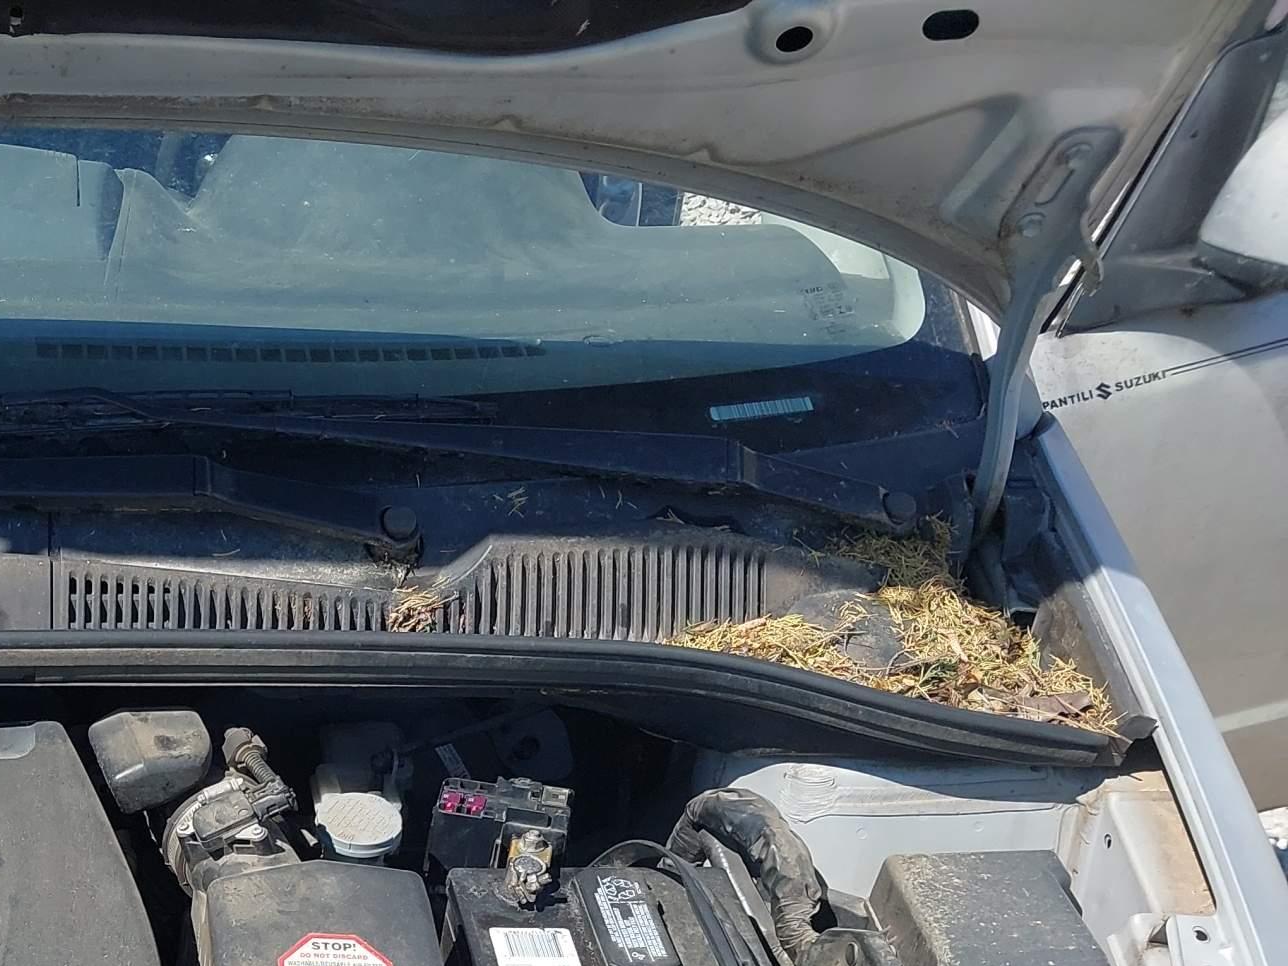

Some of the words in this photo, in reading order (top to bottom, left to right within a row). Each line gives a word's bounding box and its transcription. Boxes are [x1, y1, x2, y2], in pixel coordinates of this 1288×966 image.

[1042, 389, 1094, 410] PANTILI
[1114, 370, 1168, 392] SUZUKI
[311, 942, 357, 952] STOP!
[333, 953, 369, 961] DISCARD
